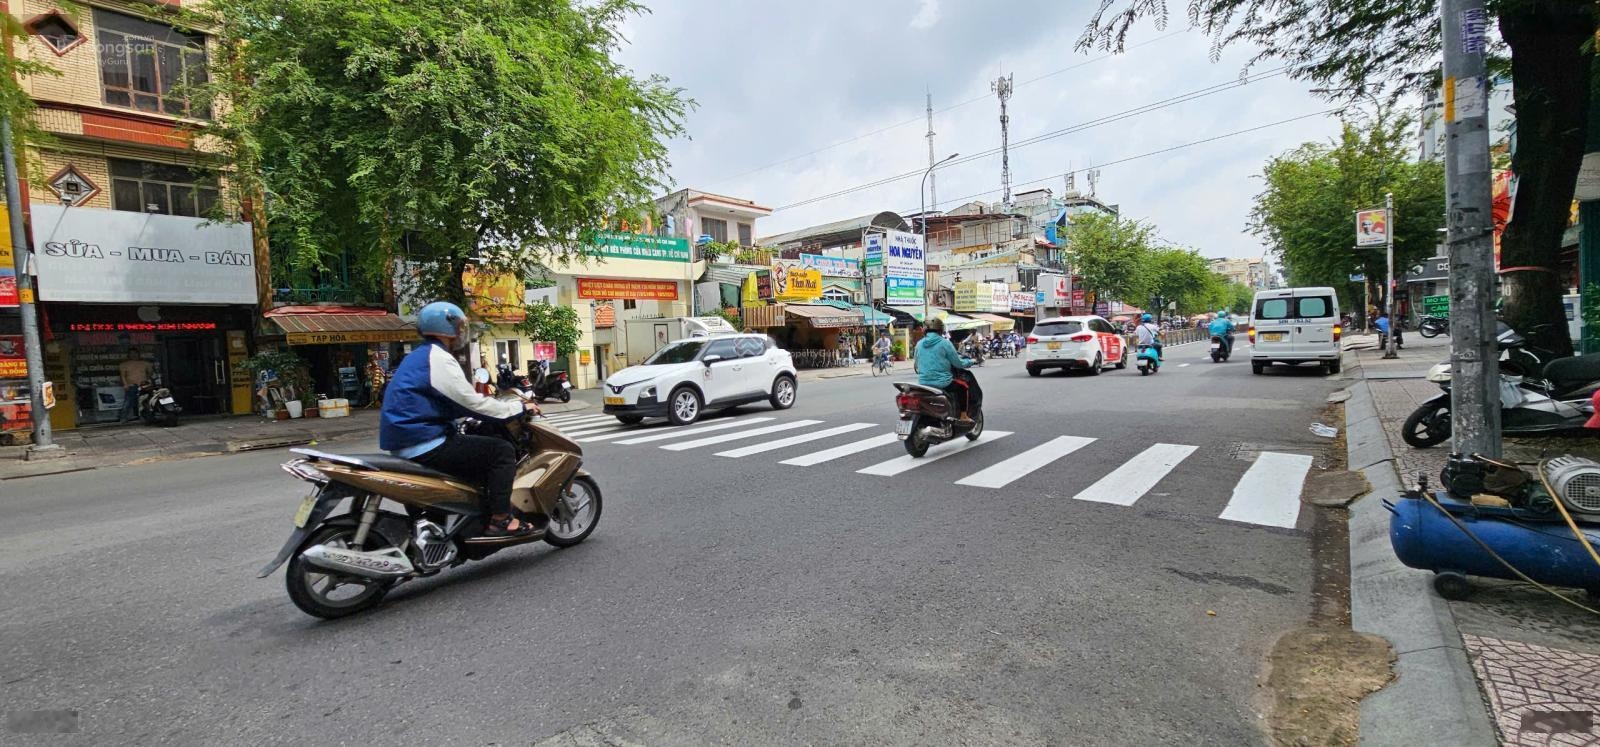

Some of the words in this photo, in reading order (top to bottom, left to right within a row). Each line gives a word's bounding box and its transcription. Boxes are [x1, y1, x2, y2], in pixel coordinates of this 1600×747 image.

[45, 239, 104, 260] SỬA
[128, 247, 184, 264] MUA
[205, 249, 252, 268] BÁN
[888, 245, 901, 258] HOA
